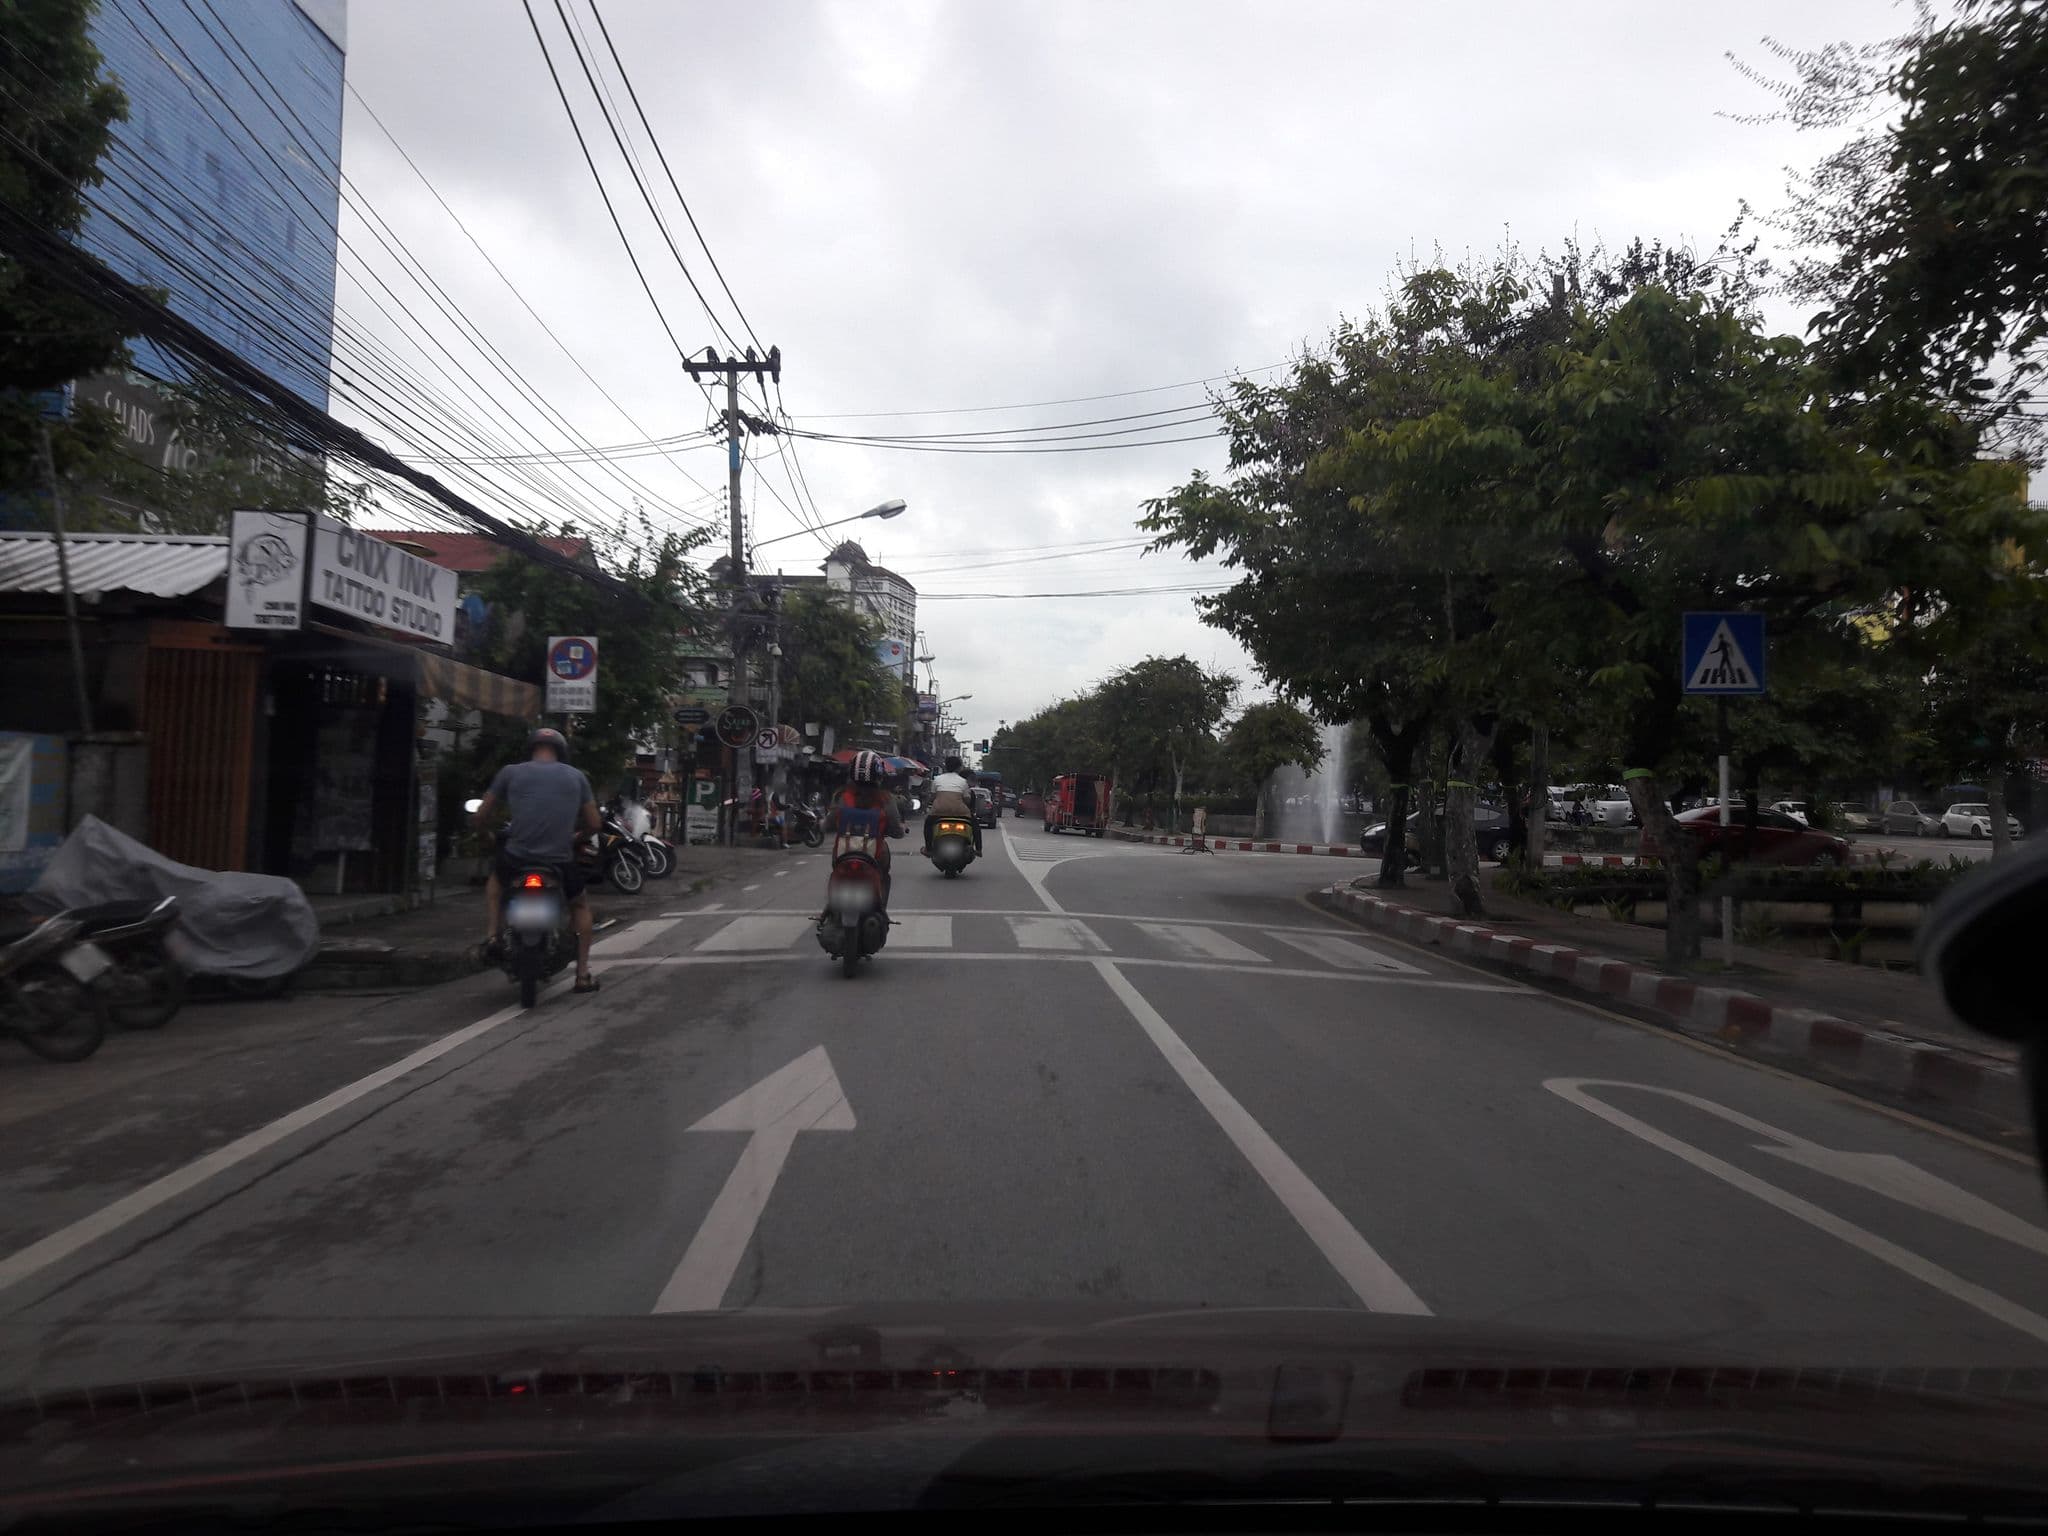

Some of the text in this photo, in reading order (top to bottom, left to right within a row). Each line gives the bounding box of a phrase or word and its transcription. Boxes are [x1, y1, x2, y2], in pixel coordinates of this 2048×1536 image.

[337, 527, 437, 602] CNX INK
[323, 569, 442, 637] TATTOO STUDIO
[695, 780, 716, 803] P
